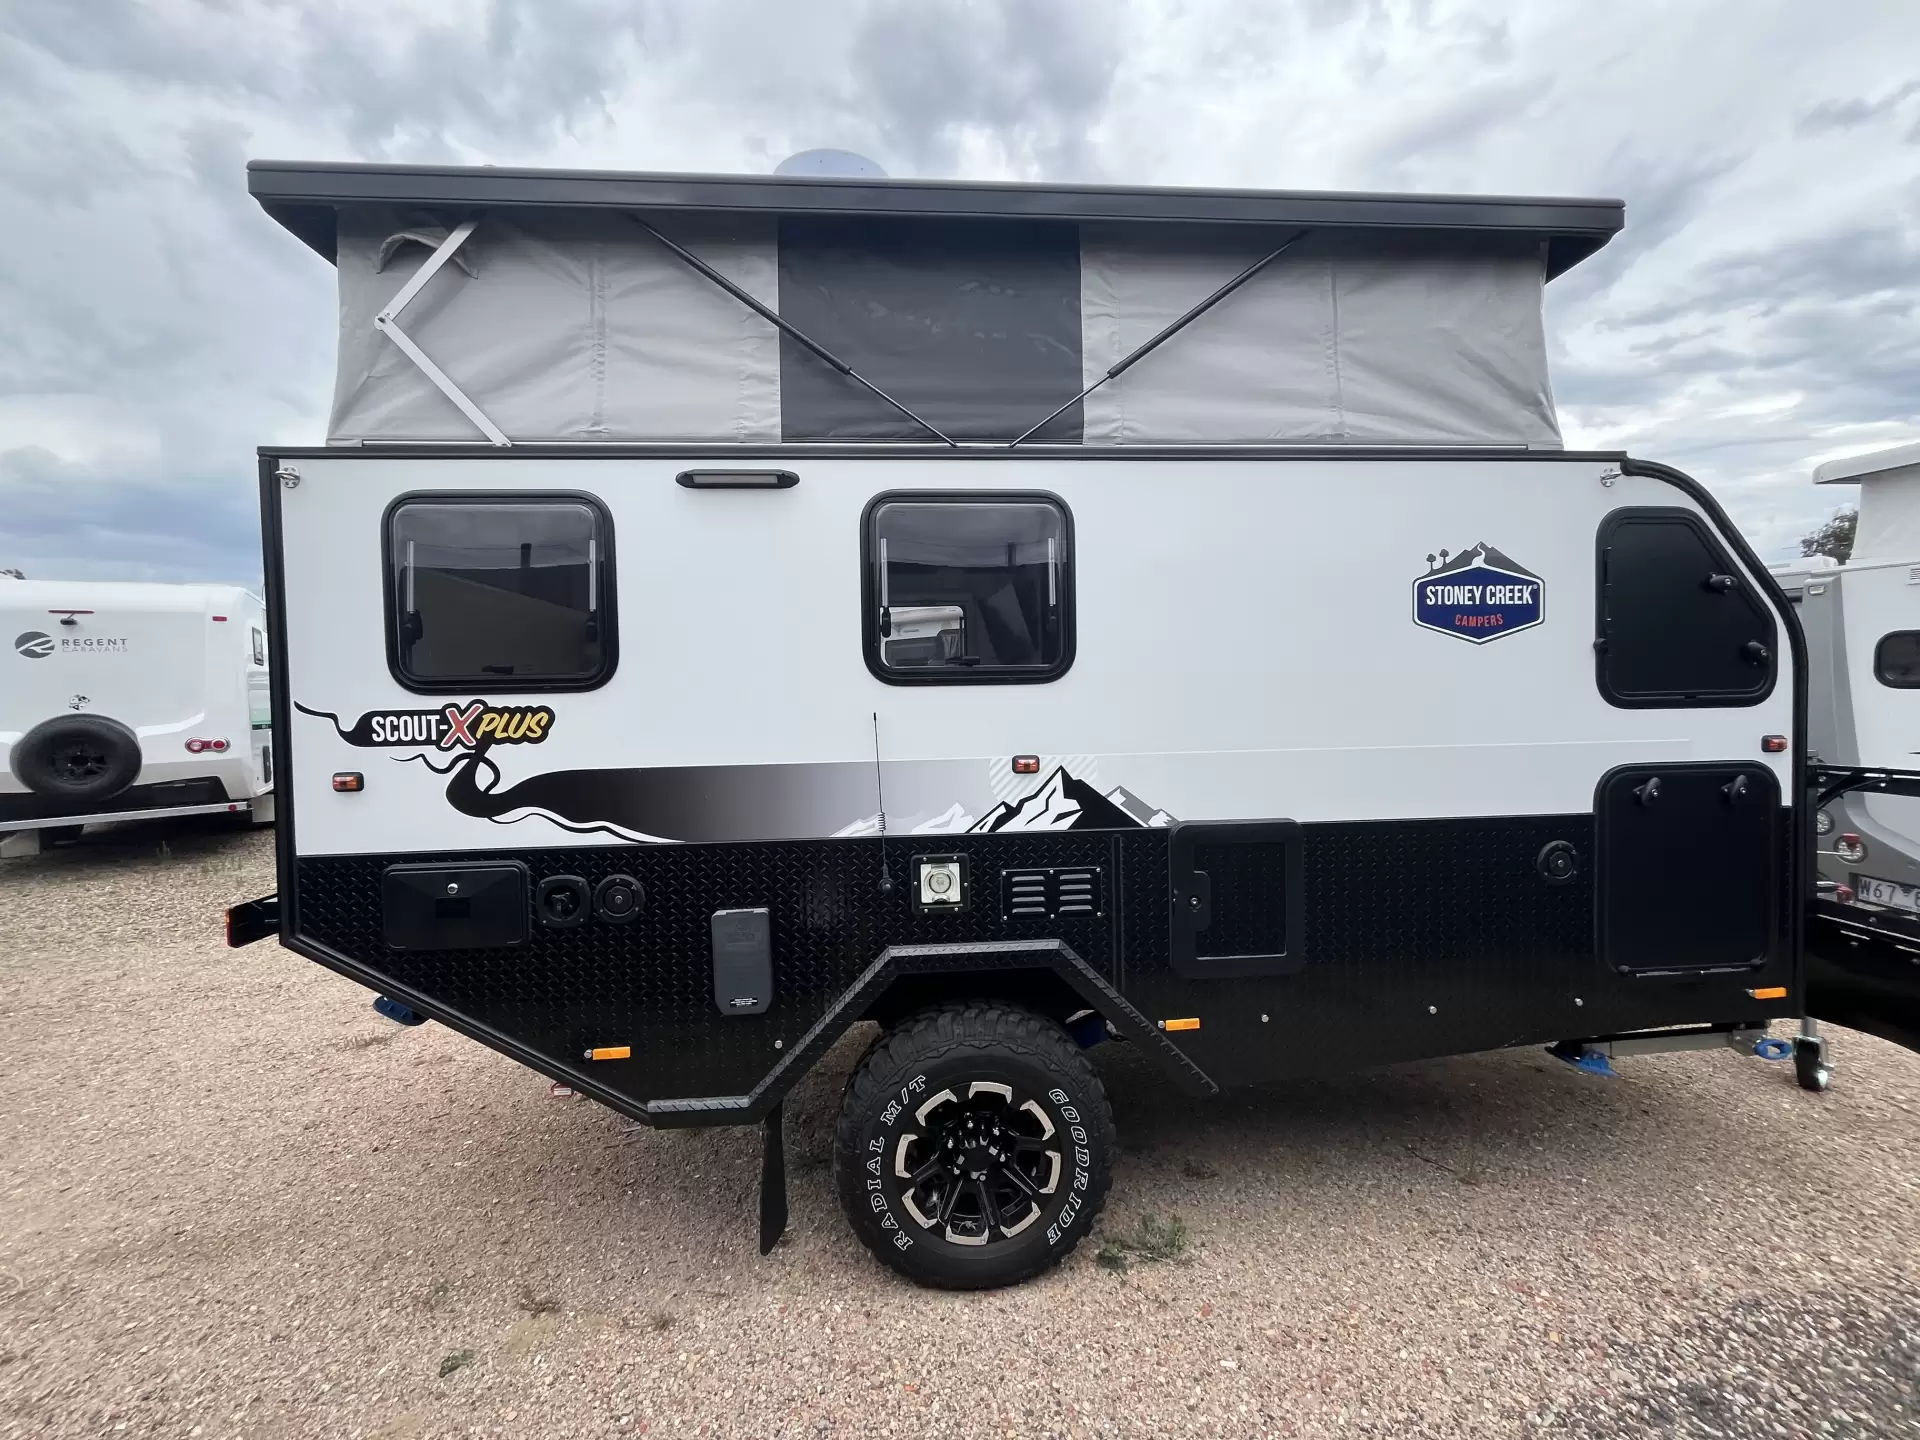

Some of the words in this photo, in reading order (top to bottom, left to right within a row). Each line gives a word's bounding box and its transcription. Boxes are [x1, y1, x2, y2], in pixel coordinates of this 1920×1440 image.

[1426, 585, 1483, 606] STONEY
[1486, 585, 1533, 605] CREEK
[1455, 614, 1504, 627] CAMPERS
[61, 638, 128, 646] REGENT
[475, 712, 549, 739] PLUS
[880, 1075, 926, 1126] M/T
[1048, 1088, 1089, 1245] GOODRIDE
[867, 1136, 914, 1251] RADIAL
